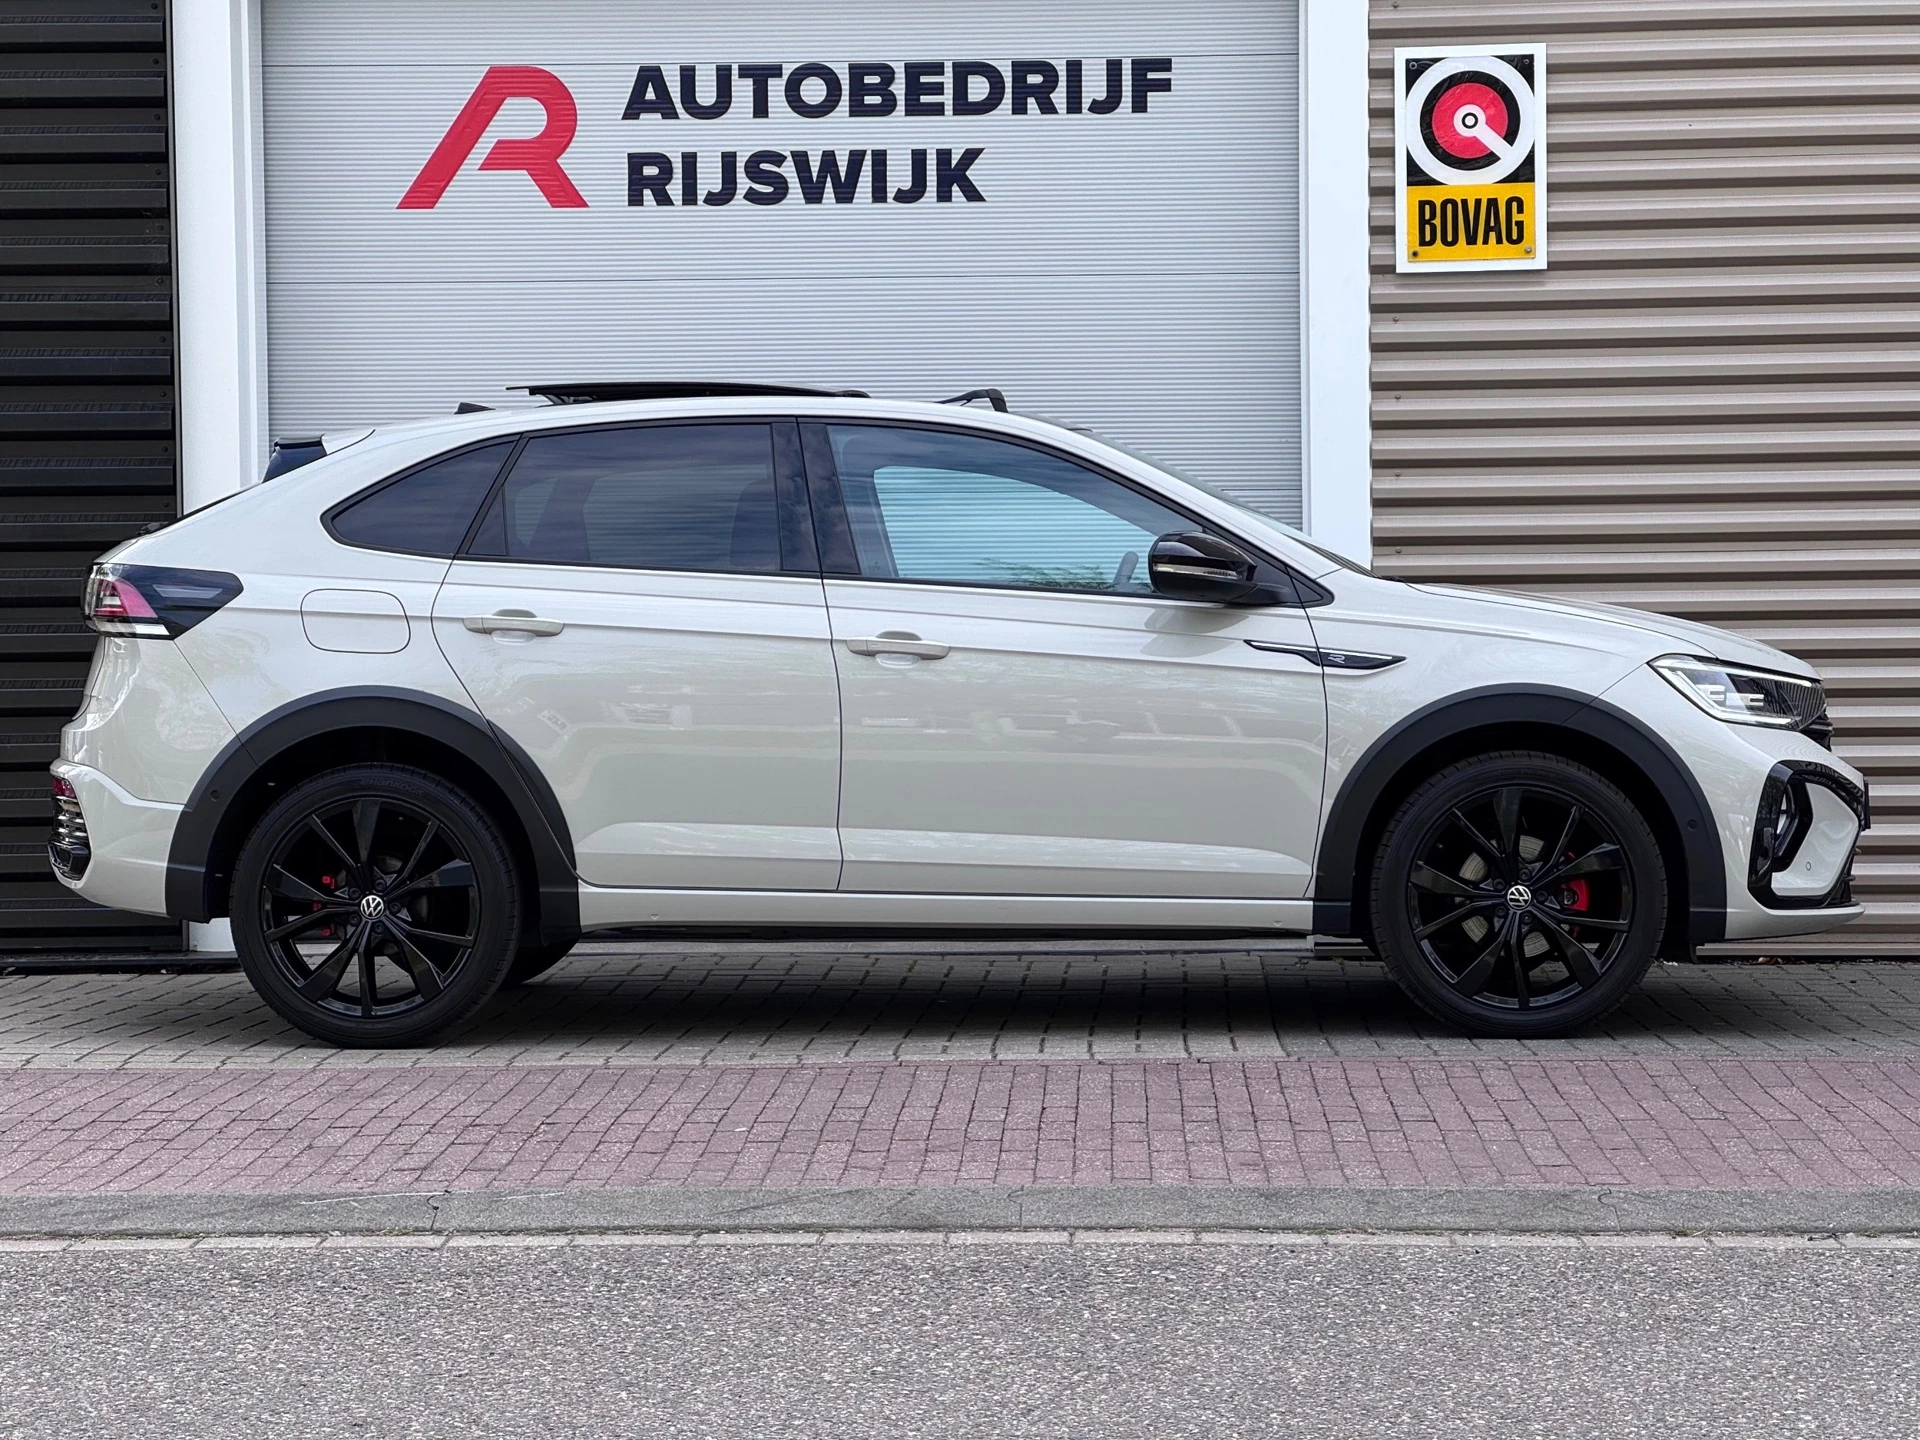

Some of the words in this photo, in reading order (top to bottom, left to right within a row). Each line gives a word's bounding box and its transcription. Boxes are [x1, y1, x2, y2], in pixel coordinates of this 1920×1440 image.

[622, 58, 1173, 120] AUTOBEDRIJF
[627, 148, 986, 207] RIJSWIJK
[1418, 196, 1525, 247] BOVAG
